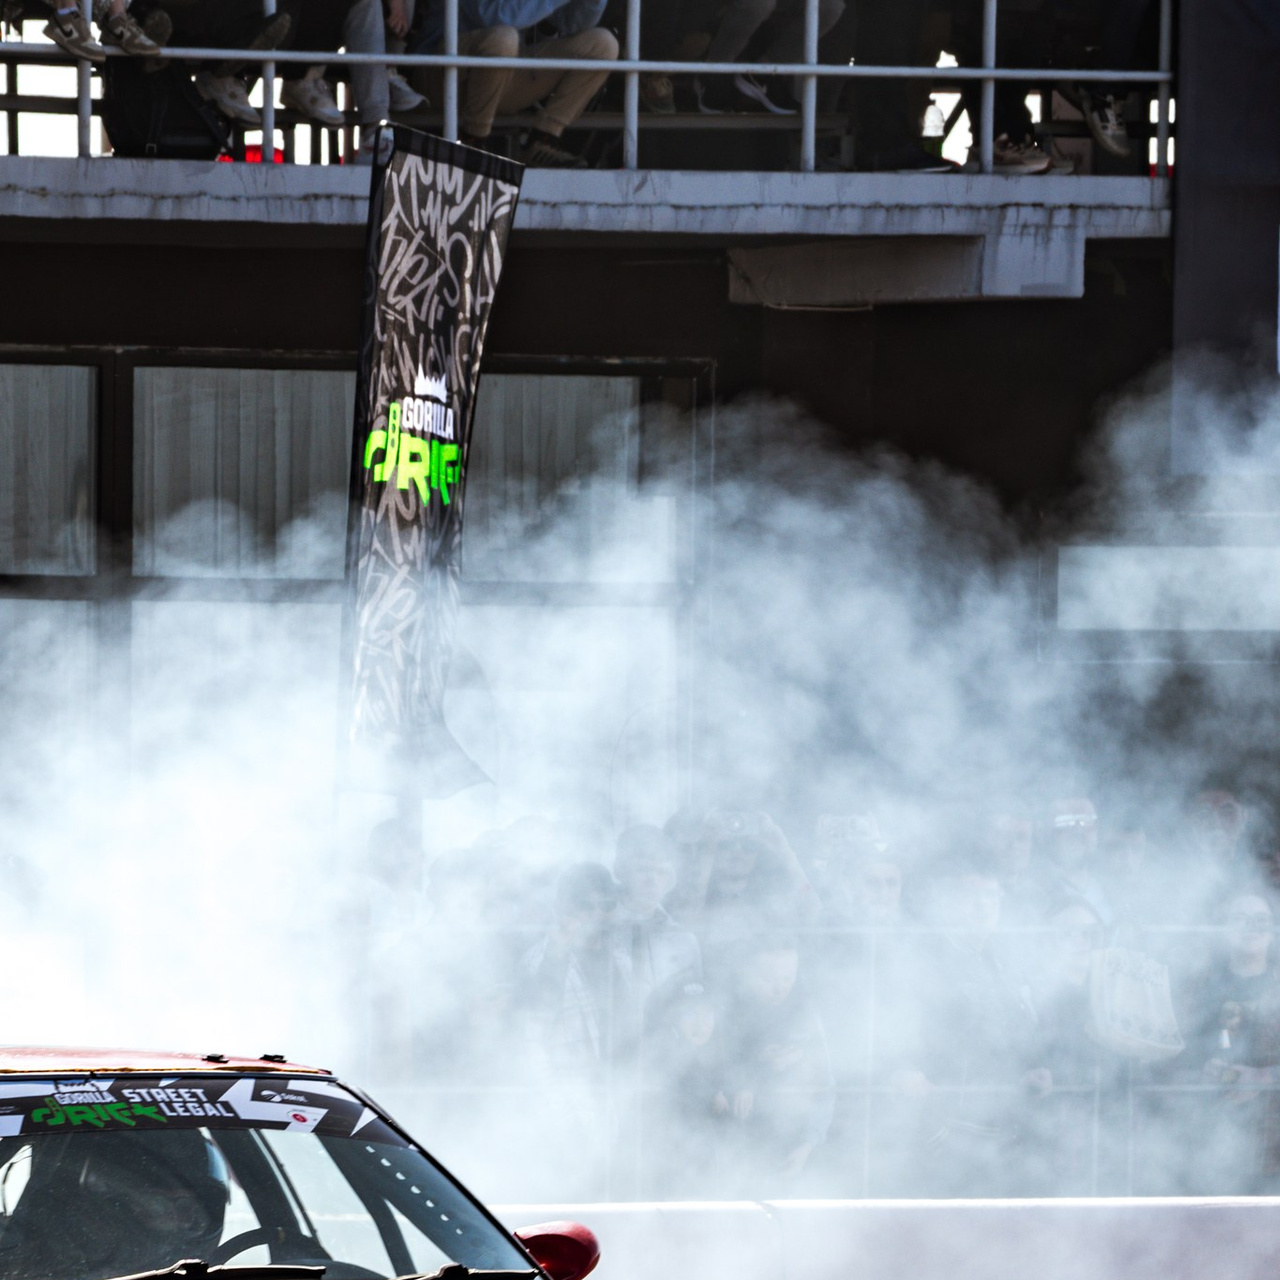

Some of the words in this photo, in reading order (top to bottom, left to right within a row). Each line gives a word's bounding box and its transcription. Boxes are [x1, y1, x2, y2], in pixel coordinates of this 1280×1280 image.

[402, 396, 454, 440] GORILLA
[53, 1090, 118, 1106] GORILLA
[121, 1087, 208, 1102] STREET
[158, 1102, 235, 1117] LEGAL
